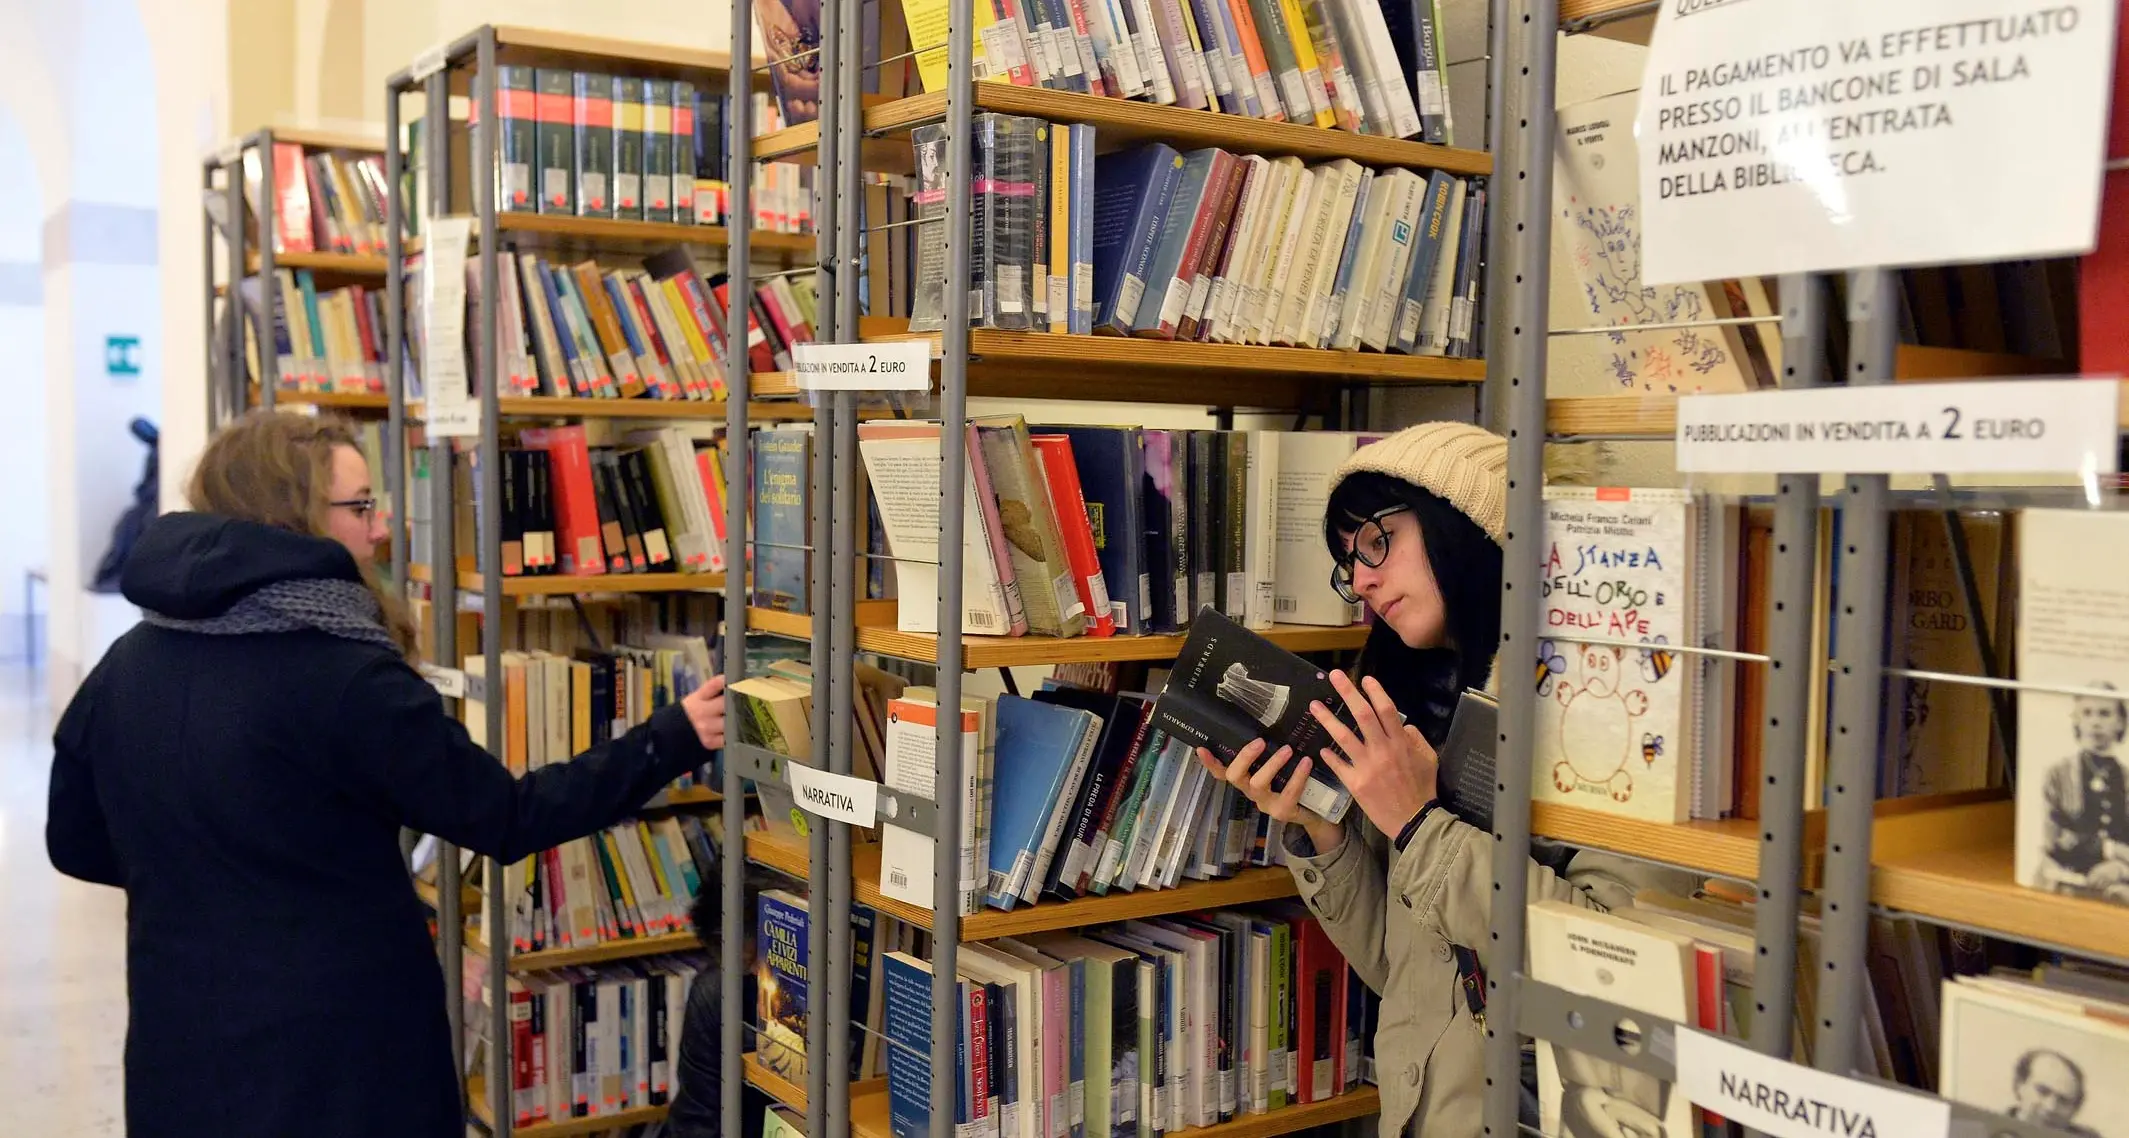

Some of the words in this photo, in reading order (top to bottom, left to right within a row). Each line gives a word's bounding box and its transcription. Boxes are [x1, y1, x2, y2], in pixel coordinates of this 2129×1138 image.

[1421, 24, 1434, 68] Borgia
[1660, 75, 1679, 97] IL
[1684, 44, 1830, 92] PAGAMENTO
[1837, 38, 1873, 64] VA
[1881, 5, 2080, 59] EFFETTUATO
[1659, 99, 1742, 131] PRESSO
[1749, 89, 1770, 117] IL
[1778, 70, 1902, 111] BANCONE
[1914, 64, 1941, 91] DI
[1953, 55, 2030, 87] SALA
[1659, 130, 1768, 165] MANZONI,
[1660, 171, 1728, 199] DELLA
[1426, 210, 1443, 240] COOK
[829, 362, 860, 373] VENDITA
[861, 364, 866, 373] A
[869, 355, 877, 373] 2
[880, 361, 906, 373] EURO
[1684, 422, 1791, 443] PUBBLICAZIONI
[1797, 422, 1815, 442] IN
[1821, 420, 1909, 441] VENDITA
[1916, 420, 1932, 440] A
[1941, 407, 1963, 440] 2
[1973, 418, 2046, 440] EURO
[1573, 544, 1664, 577] STANZA
[1655, 592, 1666, 606] E
[1548, 608, 1652, 638] DELL'APE
[1191, 635, 1219, 677] EDWARDS
[1160, 711, 1196, 733] EDWARDS
[1193, 729, 1209, 741] KIM
[802, 784, 854, 813] NARRATIVA
[1085, 782, 1101, 808] PREDA
[764, 920, 797, 949] CAMILLA
[768, 948, 807, 981] APPARENTI
[1720, 1070, 1877, 1138] NARRATIVA
